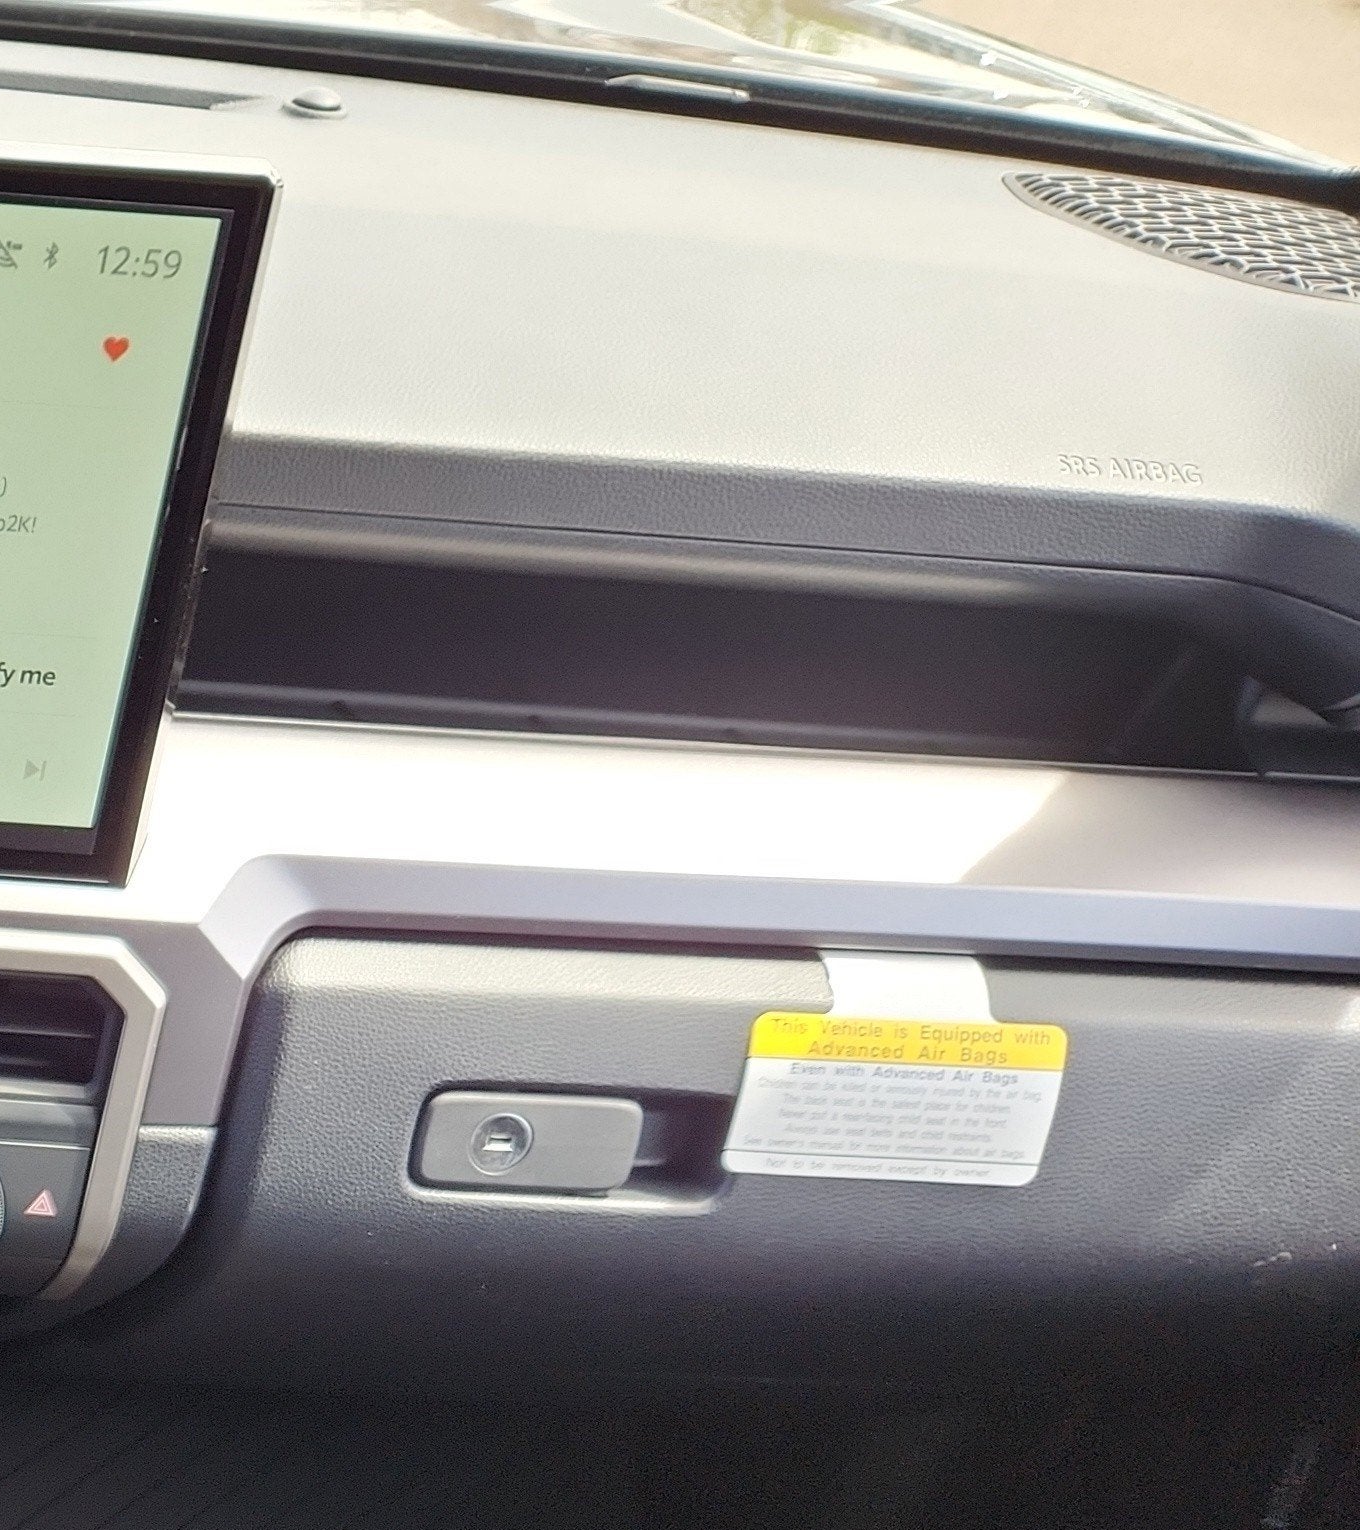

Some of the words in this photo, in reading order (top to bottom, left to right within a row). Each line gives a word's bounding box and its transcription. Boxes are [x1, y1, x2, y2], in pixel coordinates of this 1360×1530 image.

[98, 245, 183, 280] 12:59
[1057, 453, 1101, 478] SRS
[1108, 457, 1204, 488] AIRBAG
[20, 669, 56, 687] me
[771, 1018, 809, 1036] This
[820, 1021, 884, 1038] Vehicle
[894, 1025, 909, 1040] is
[920, 1025, 1003, 1047] Equipped
[1014, 1031, 1050, 1046] with
[807, 1041, 905, 1060] Advanced
[917, 1044, 945, 1060] Air
[961, 1047, 1008, 1065] Bags
[790, 1063, 827, 1076] Even
[835, 1064, 865, 1077] with
[872, 1066, 945, 1081] Advanced
[953, 1069, 975, 1082] Air
[982, 1071, 1019, 1086] Bags
